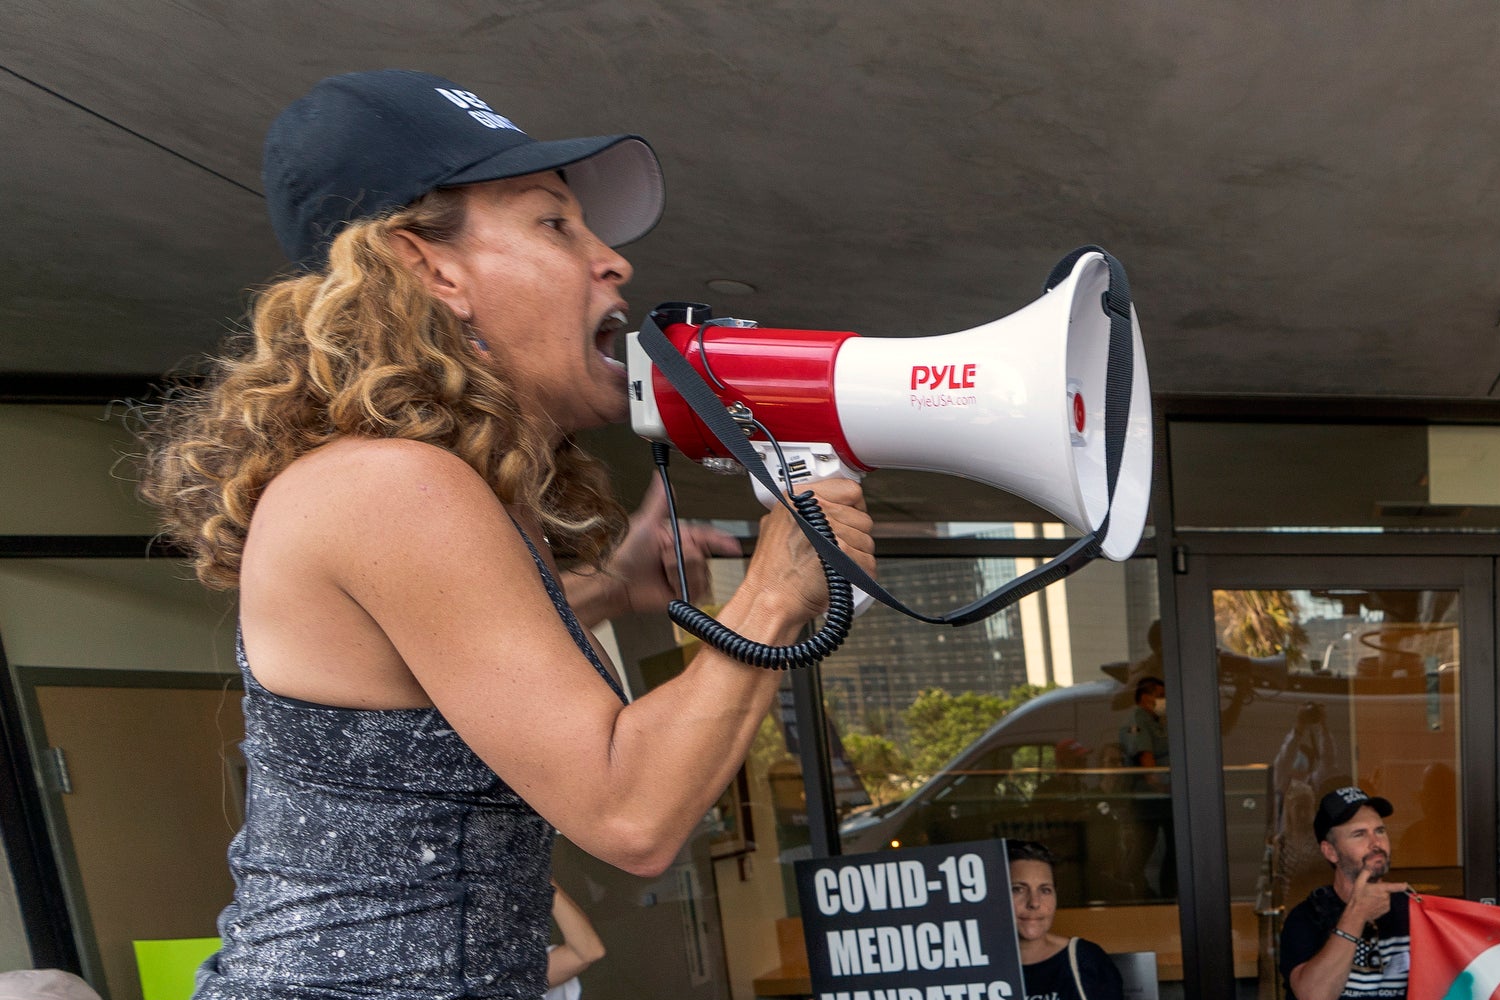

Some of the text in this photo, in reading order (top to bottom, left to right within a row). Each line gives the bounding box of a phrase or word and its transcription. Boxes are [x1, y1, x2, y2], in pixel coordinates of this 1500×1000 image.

[911, 364, 977, 391] PYLE
[910, 394, 978, 411] PyleUSA.com
[814, 853, 987, 916] COVID-19
[826, 919, 990, 976] MEDICAL
